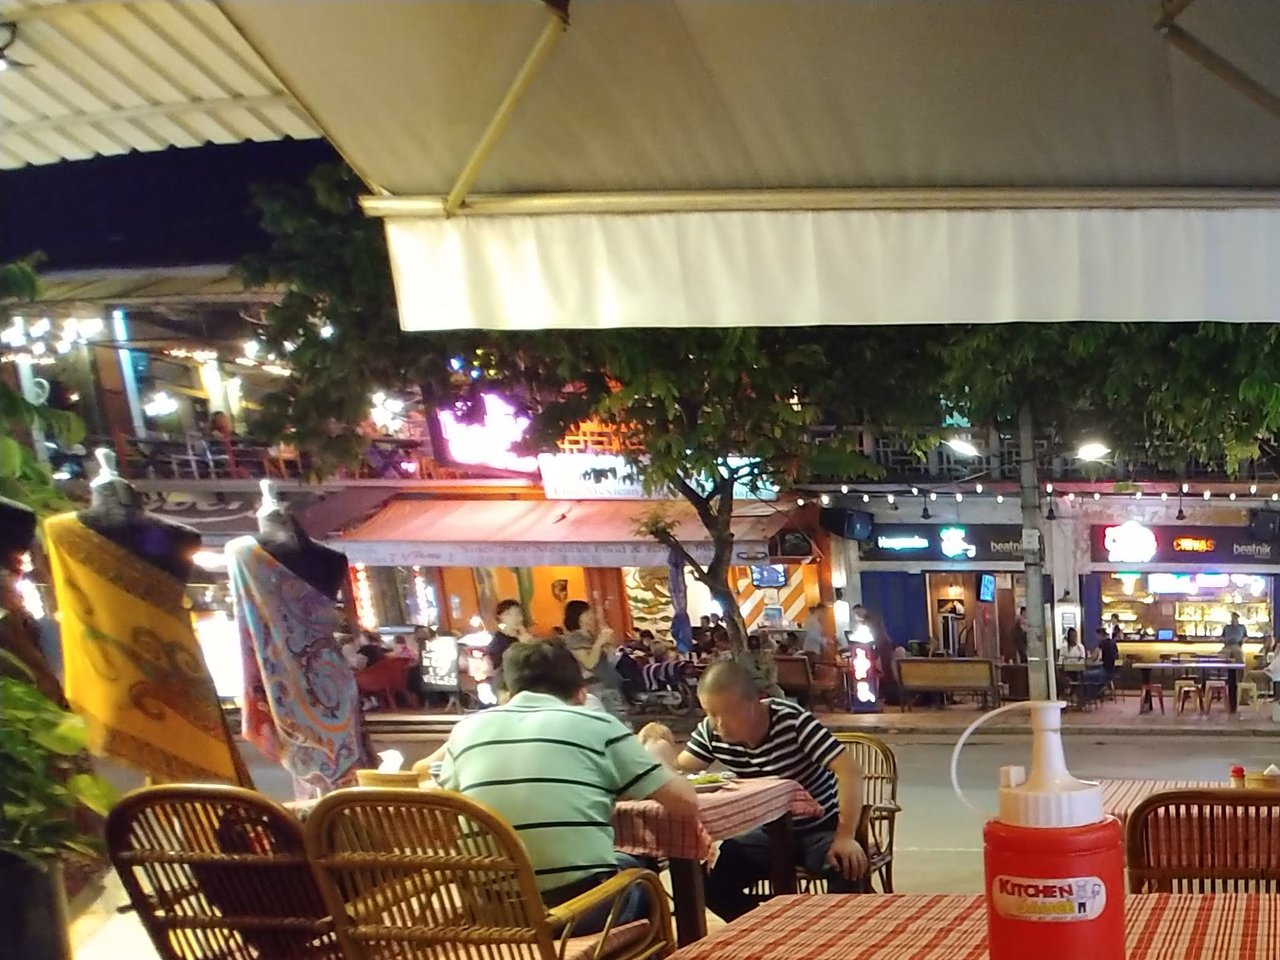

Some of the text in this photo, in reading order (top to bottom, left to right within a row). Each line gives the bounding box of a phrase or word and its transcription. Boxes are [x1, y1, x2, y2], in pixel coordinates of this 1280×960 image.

[587, 487, 639, 496] Mexican
[1233, 543, 1272, 555] beatnik
[999, 878, 1074, 898] KITCHEN
